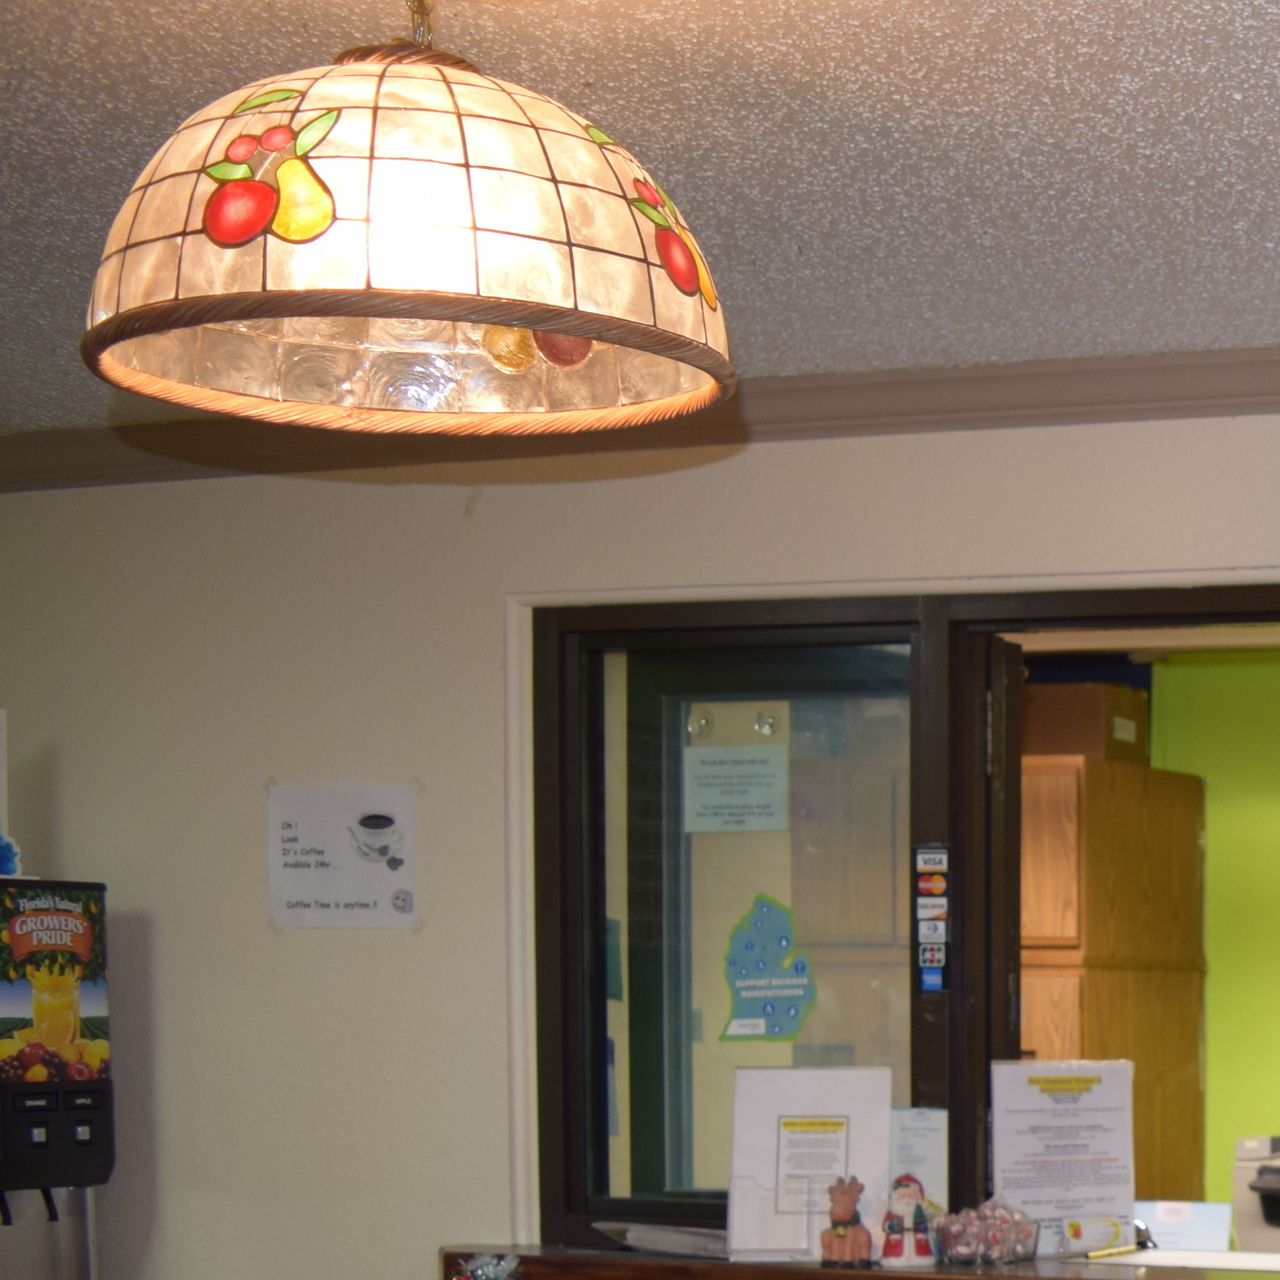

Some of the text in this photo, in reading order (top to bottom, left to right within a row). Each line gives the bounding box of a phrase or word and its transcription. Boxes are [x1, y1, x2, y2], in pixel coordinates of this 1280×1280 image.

[300, 847, 325, 856] Coffee
[922, 857, 943, 866] VISA
[286, 900, 311, 909] Coffee
[31, 931, 73, 946] PRIDE
